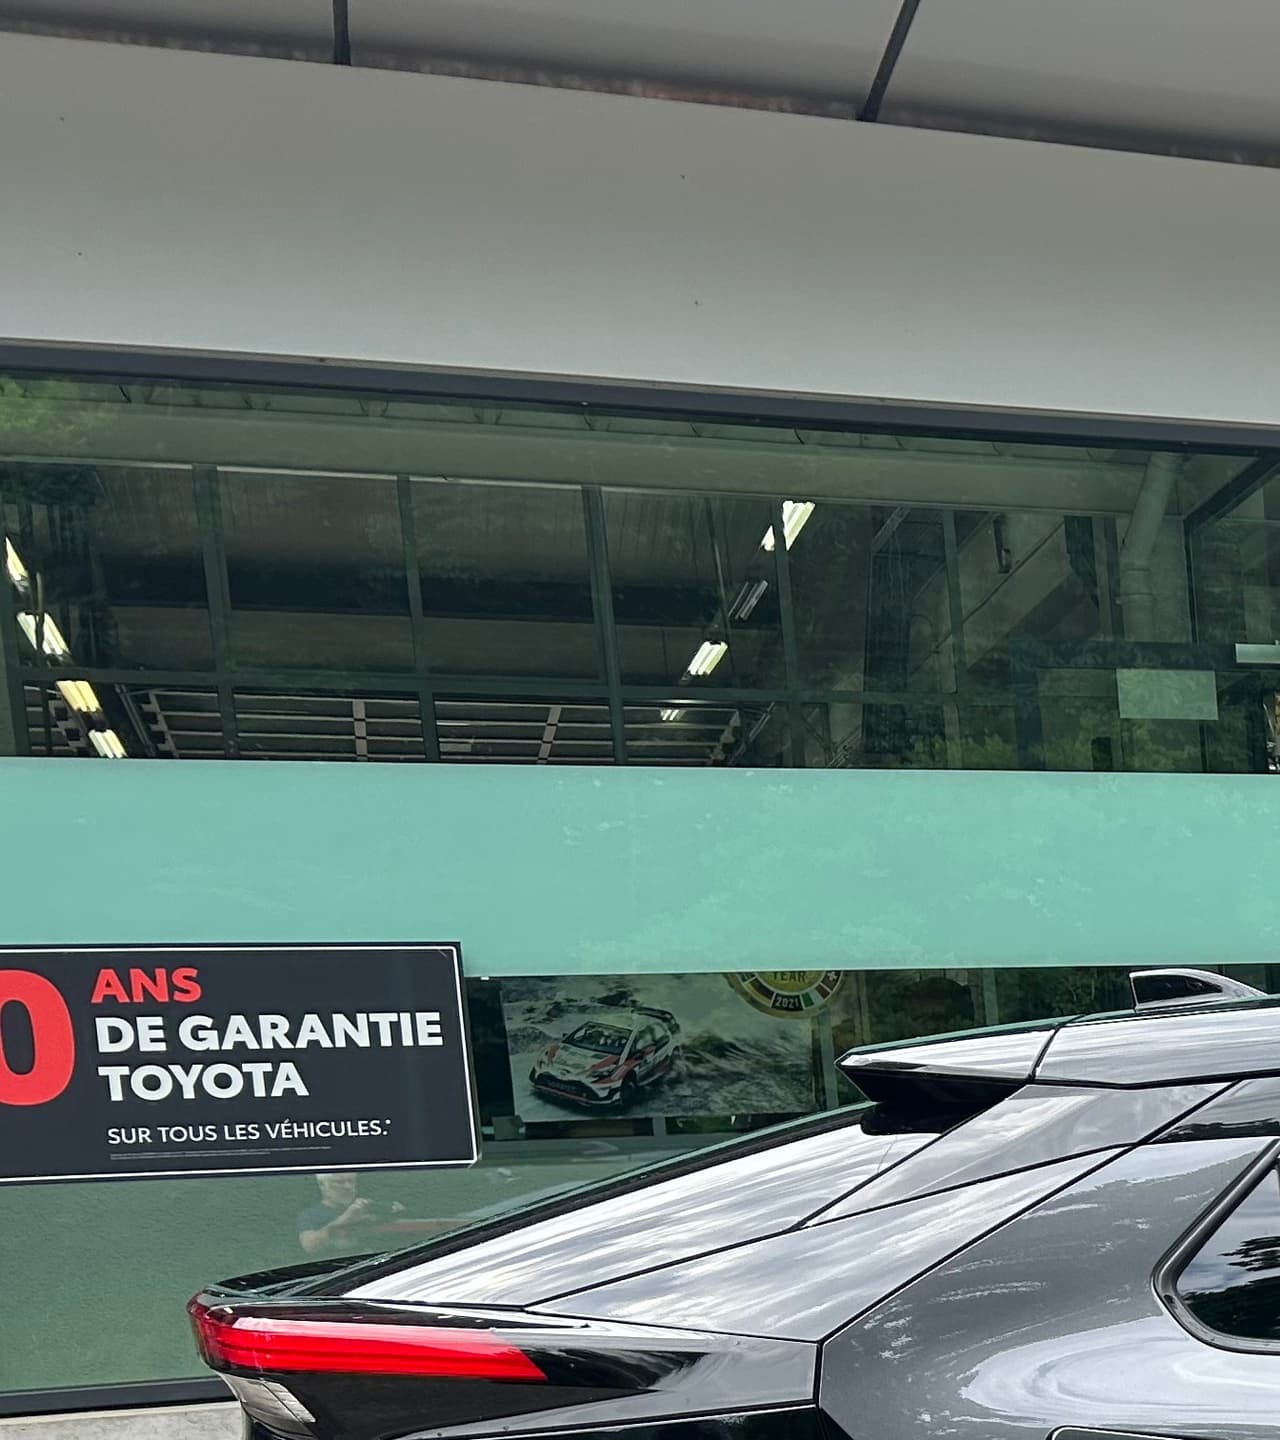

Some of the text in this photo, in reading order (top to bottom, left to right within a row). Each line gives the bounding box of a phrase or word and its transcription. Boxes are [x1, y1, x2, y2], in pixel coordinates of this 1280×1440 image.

[90, 967, 202, 1004] ANS
[775, 996, 800, 1009] 2021
[95, 1011, 444, 1054] DE GARANTIE
[97, 1062, 310, 1102] TOYOTA
[107, 1127, 152, 1145] SUR
[157, 1124, 218, 1143] TOUS
[223, 1123, 261, 1141] LES
